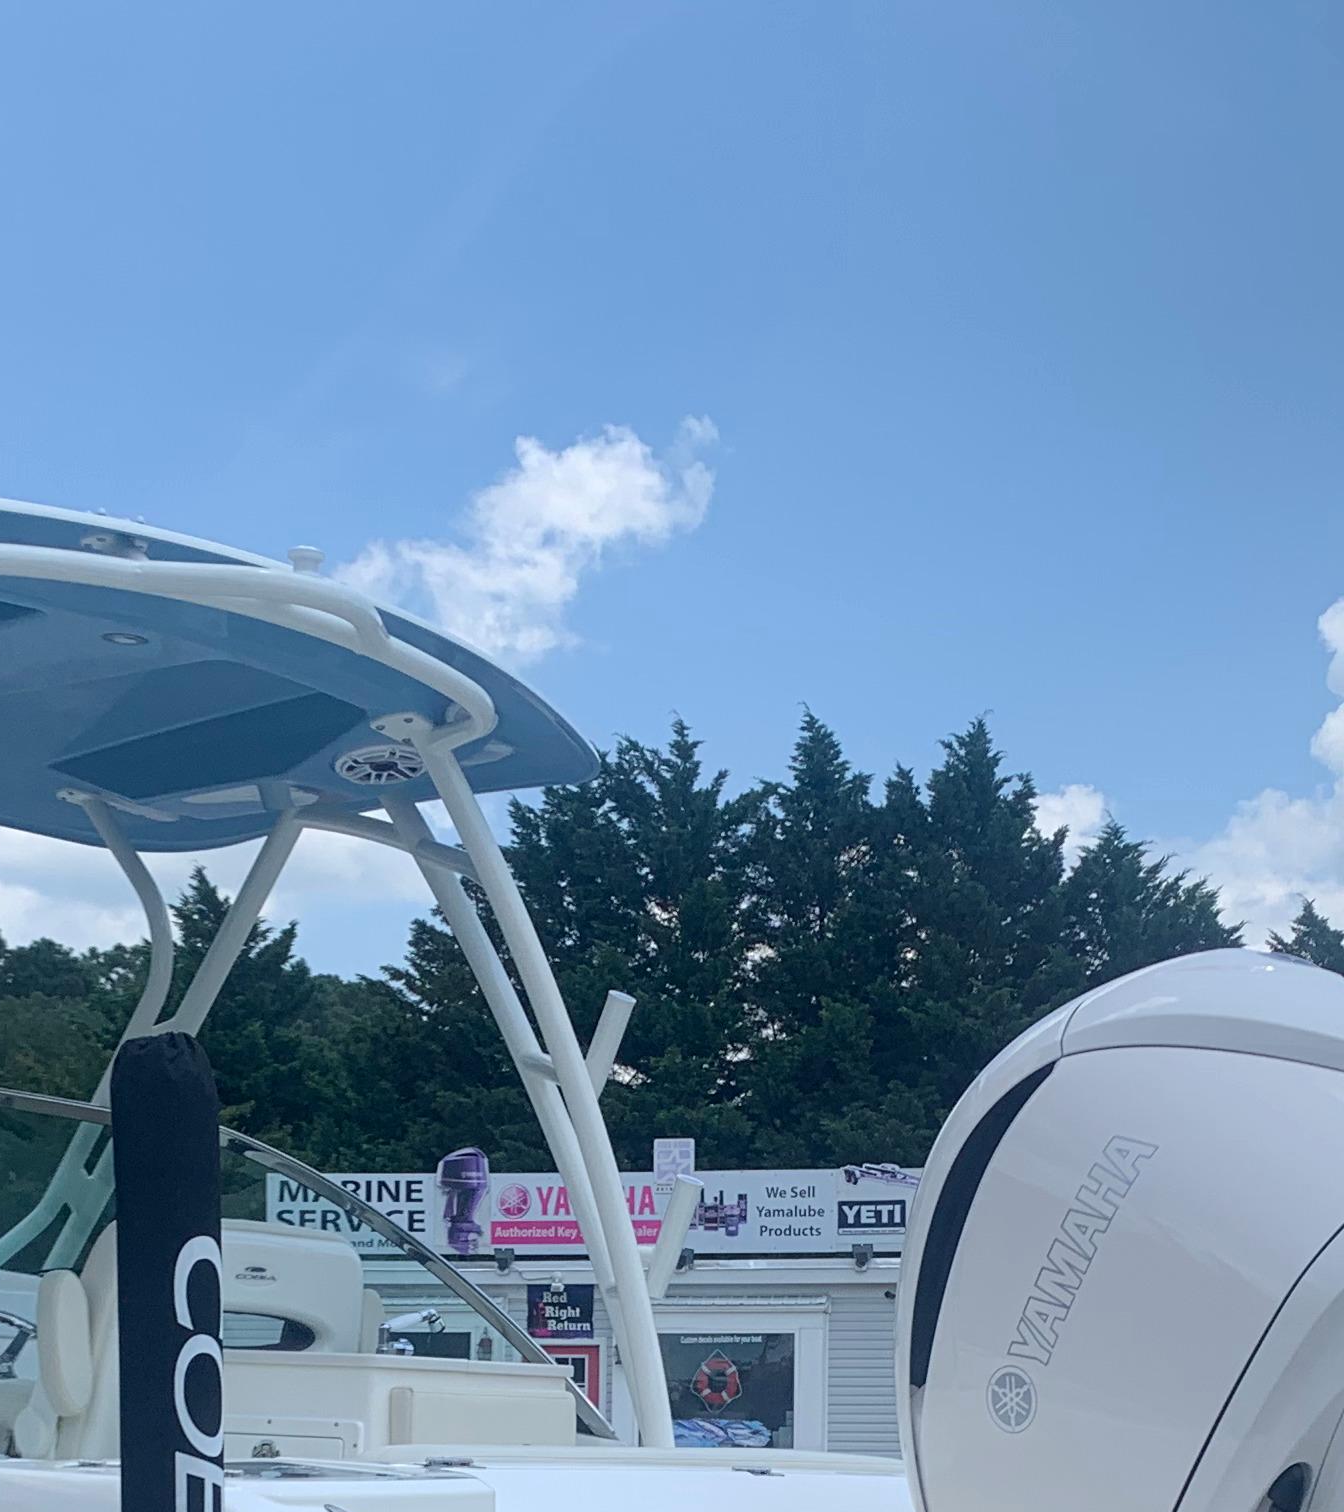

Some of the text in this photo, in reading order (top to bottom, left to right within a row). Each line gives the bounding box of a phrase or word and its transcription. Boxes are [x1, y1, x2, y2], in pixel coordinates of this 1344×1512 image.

[279, 1180, 424, 1203] MRINE
[765, 1186, 816, 1199] We Sell
[535, 1185, 655, 1216] YAHA
[756, 1205, 825, 1219] Yamalube
[841, 1204, 902, 1225] YETI
[494, 1226, 555, 1238] Authorized
[557, 1226, 578, 1240] Key
[760, 1225, 822, 1237] Products
[1007, 1135, 1159, 1366] YAMAHA
[542, 1291, 568, 1303] Red
[544, 1306, 581, 1321] Right
[547, 1320, 592, 1331] Return
